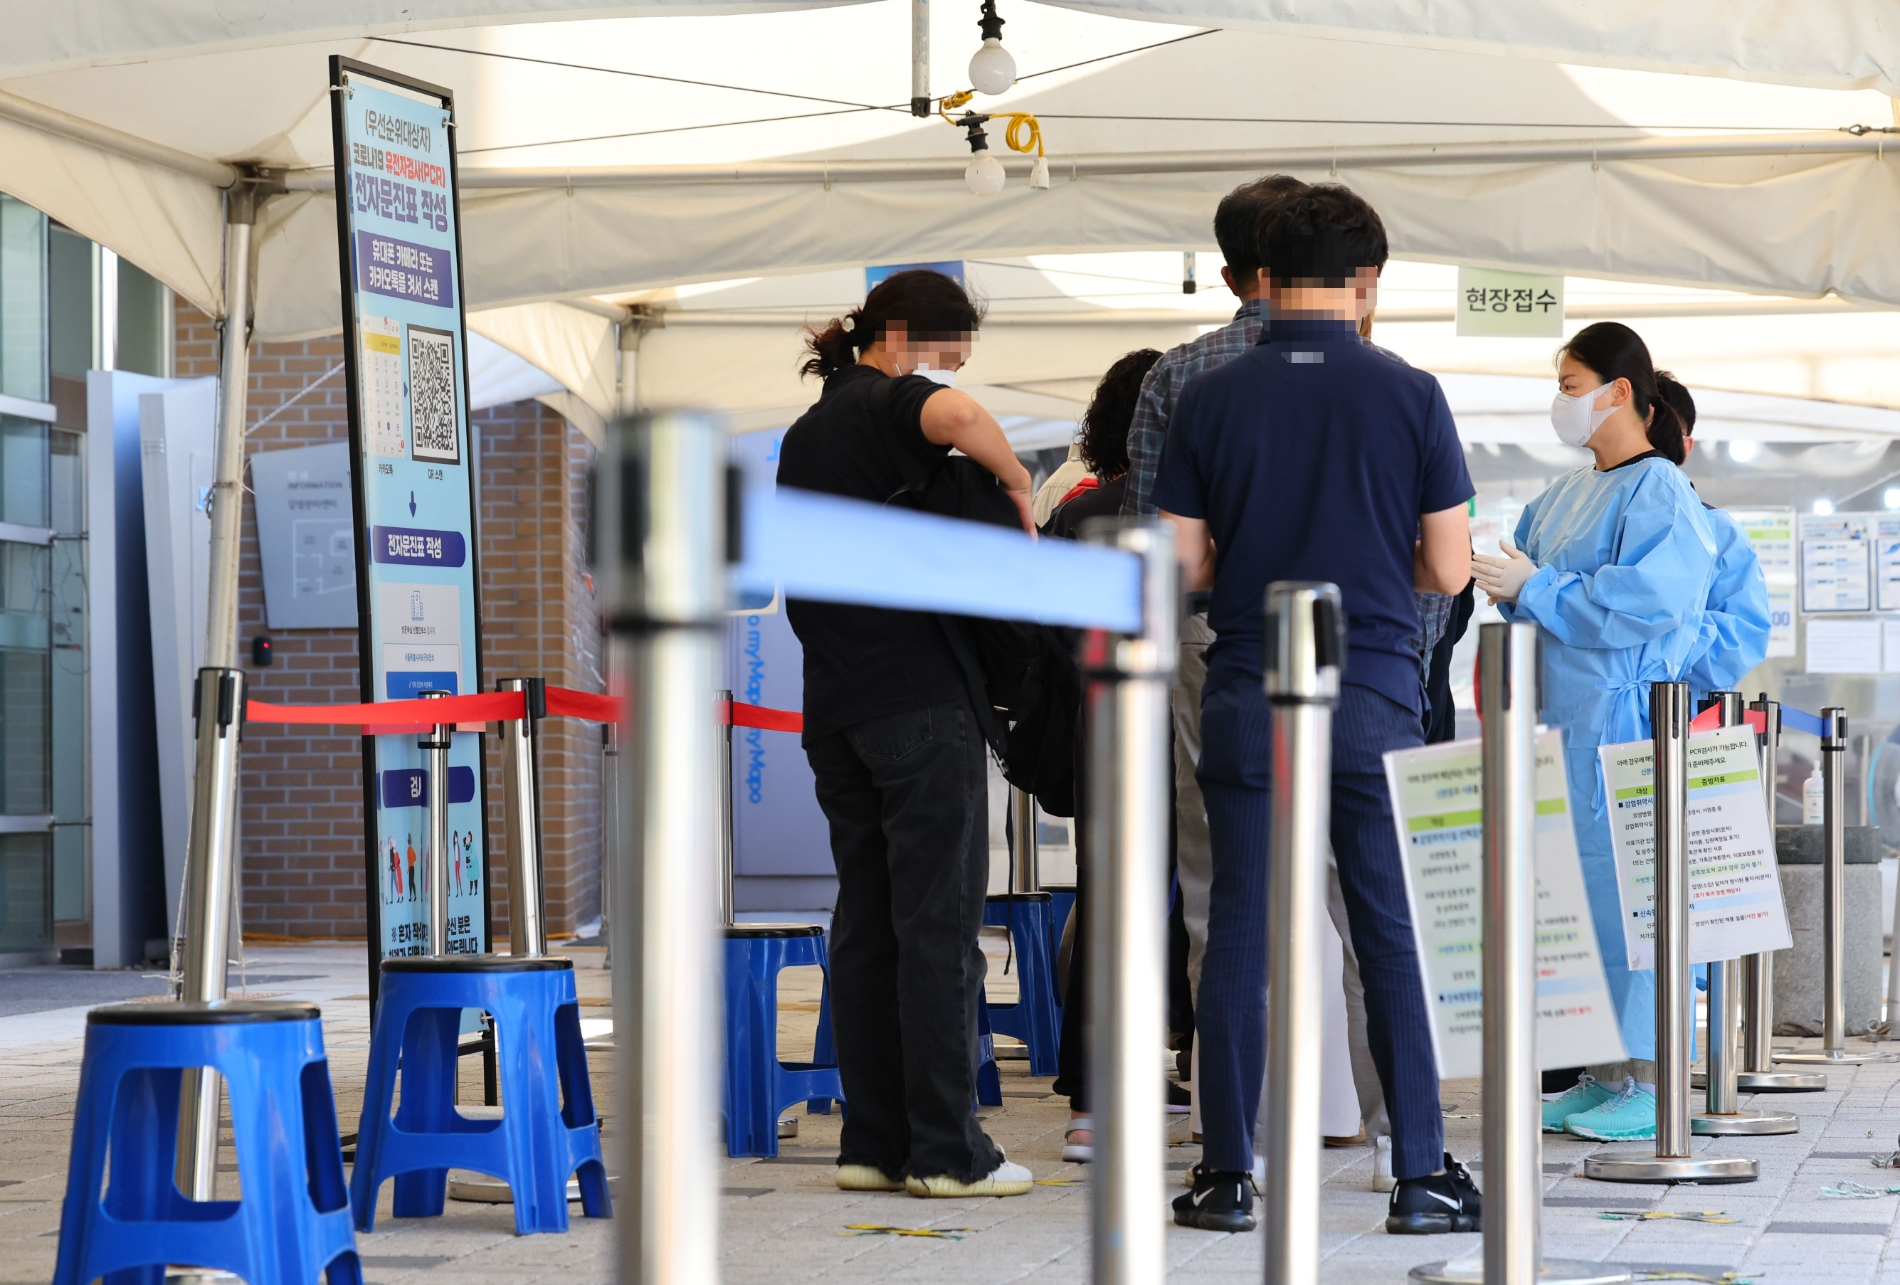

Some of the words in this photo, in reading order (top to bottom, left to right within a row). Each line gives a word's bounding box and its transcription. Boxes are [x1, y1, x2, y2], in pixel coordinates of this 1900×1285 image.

[365, 109, 430, 153] (우선순위대상자)
[353, 142, 384, 171] 코로나19
[385, 151, 446, 188] 유전자검사(PCR)
[355, 171, 419, 224] 전자문진표
[421, 189, 448, 232] 작성
[372, 239, 395, 265] 휴대폰
[396, 245, 418, 270] 카메라
[420, 251, 433, 273] 또는
[369, 265, 406, 294] 카카오톡을
[407, 273, 422, 297] 켜서
[423, 277, 439, 300] 스캔
[1466, 287, 1557, 313] 현장접수
[388, 534, 425, 557] 전자문진표
[426, 537, 442, 558] 작성
[744, 630, 765, 706] myMap
[1629, 756, 1644, 766] 경우에
[1690, 746, 1718, 755] PCR검사가
[1719, 741, 1749, 751] 가능합니다.
[1641, 767, 1653, 776] 신분
[1693, 757, 1726, 768] 준비해주세요
[410, 776, 421, 797] 검
[1702, 776, 1725, 786] 증빙자료
[1625, 797, 1653, 808] 감염취약시
[1691, 867, 1716, 876] 상주보호자
[398, 923, 411, 943] 혼자
[458, 915, 470, 934] 분은
